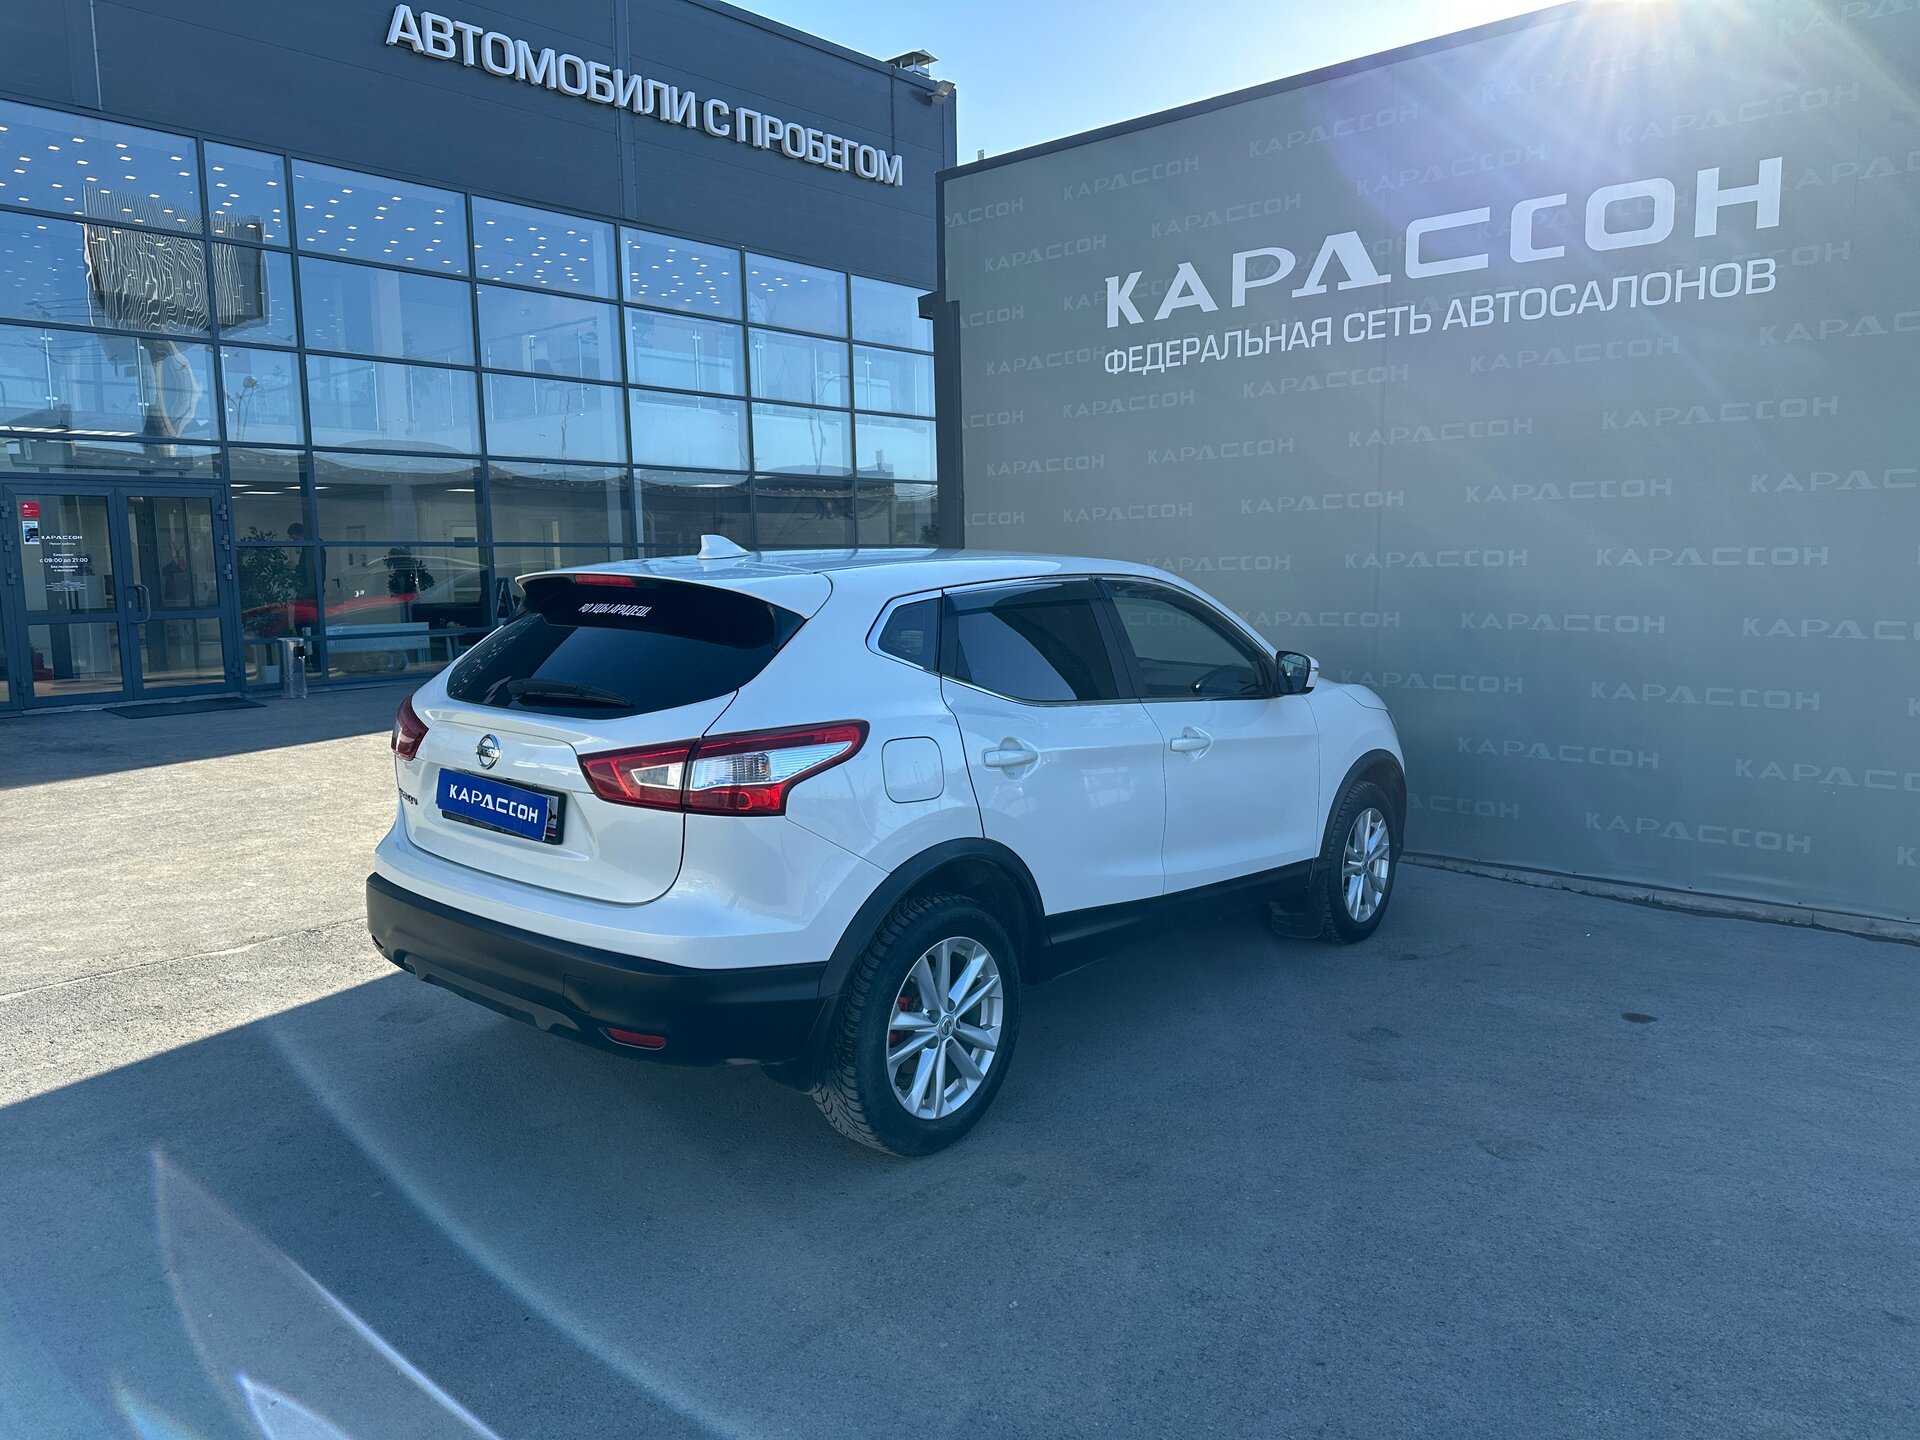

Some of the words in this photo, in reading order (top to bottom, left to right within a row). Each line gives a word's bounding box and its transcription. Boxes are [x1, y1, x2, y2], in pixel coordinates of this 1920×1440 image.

[386, 4, 697, 129] АВТОМОБИЛИ
[704, 98, 730, 138] С
[736, 107, 904, 187] ПРОБЕГОМ
[1104, 315, 1332, 376] ФЕДЕРАЛЬНАЯ
[1343, 303, 1431, 344] СЕТЬ
[1442, 257, 1777, 331] АВТОСАЛОНОВ
